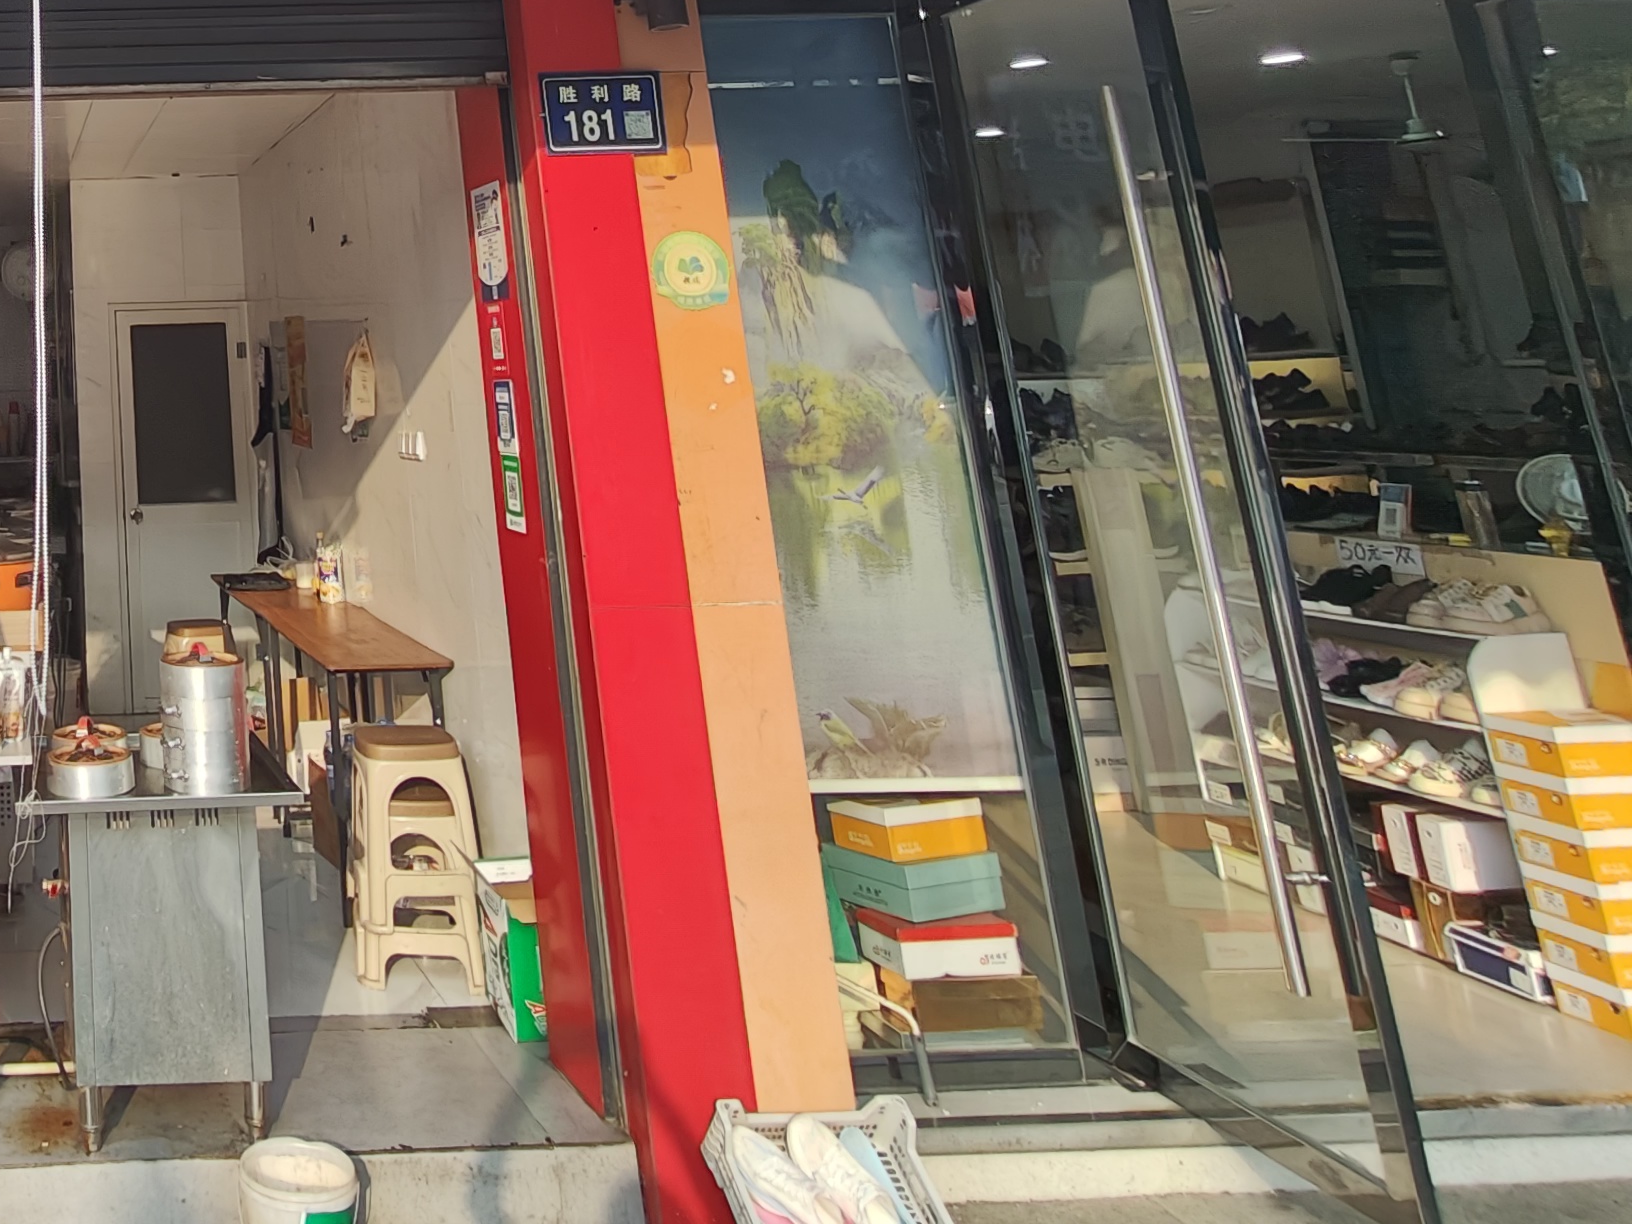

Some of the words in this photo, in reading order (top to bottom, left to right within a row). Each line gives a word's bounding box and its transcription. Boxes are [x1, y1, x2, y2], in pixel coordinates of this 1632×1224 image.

[558, 83, 642, 104] 胜利路
[563, 108, 616, 142] 181
